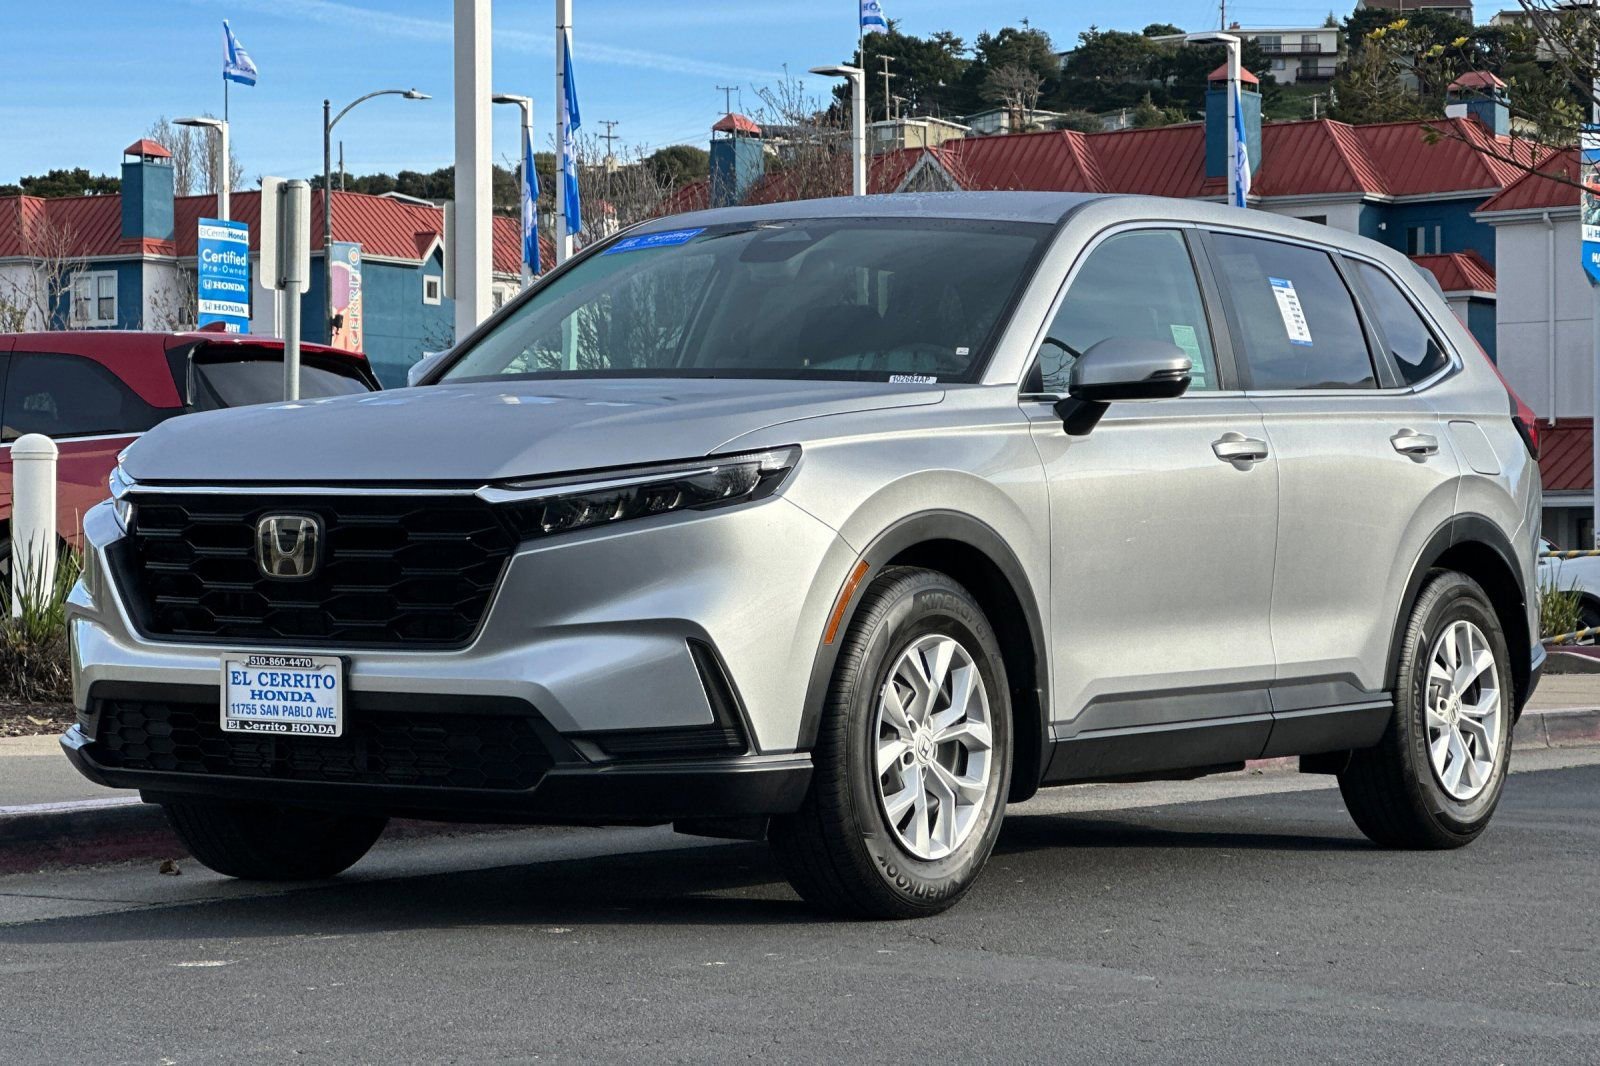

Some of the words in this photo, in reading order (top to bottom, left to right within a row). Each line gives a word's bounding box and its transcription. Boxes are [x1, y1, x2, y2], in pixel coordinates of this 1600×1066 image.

[202, 248, 247, 266] Certified
[203, 263, 247, 276] Pre-Owned
[213, 280, 246, 292] HONDA
[213, 303, 245, 314] HONDA
[250, 656, 312, 667] 510-860-4470
[231, 671, 252, 686] EL
[257, 672, 336, 689] CERRITO
[250, 689, 316, 703] HONDA
[231, 703, 257, 715] 11755
[260, 704, 279, 716] SAN
[282, 705, 313, 718] PABLO
[316, 707, 337, 719] AVE.
[227, 720, 240, 729] El
[291, 724, 335, 734] HONDA
